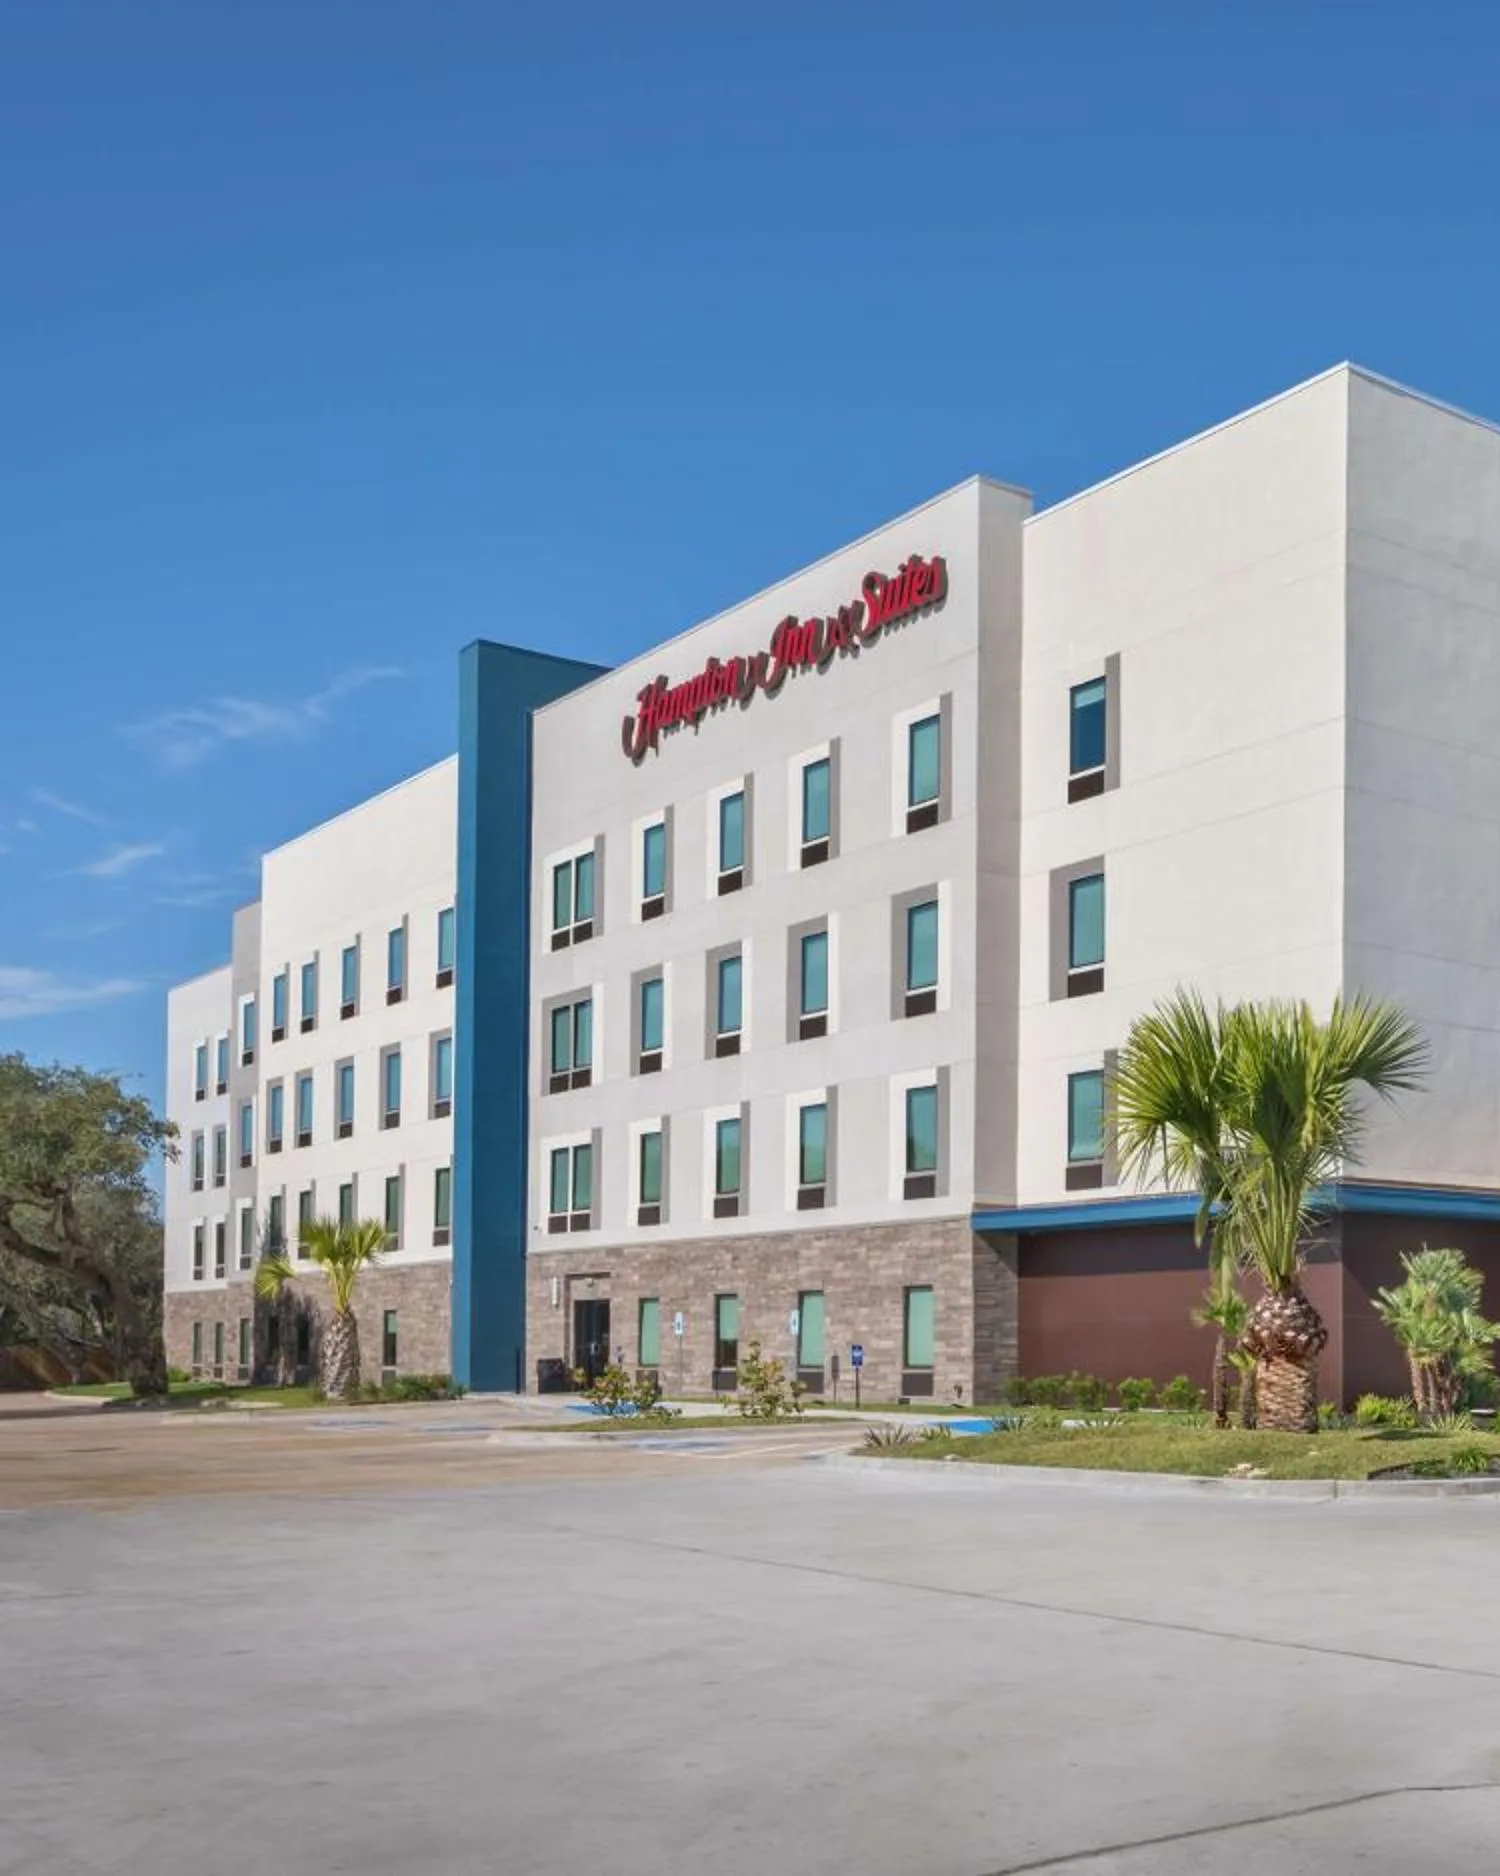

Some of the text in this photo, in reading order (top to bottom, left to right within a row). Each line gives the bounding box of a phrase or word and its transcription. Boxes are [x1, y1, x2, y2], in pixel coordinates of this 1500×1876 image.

[622, 656, 757, 767] Hampton
[756, 615, 834, 698] Inn
[853, 554, 948, 648] Suites
